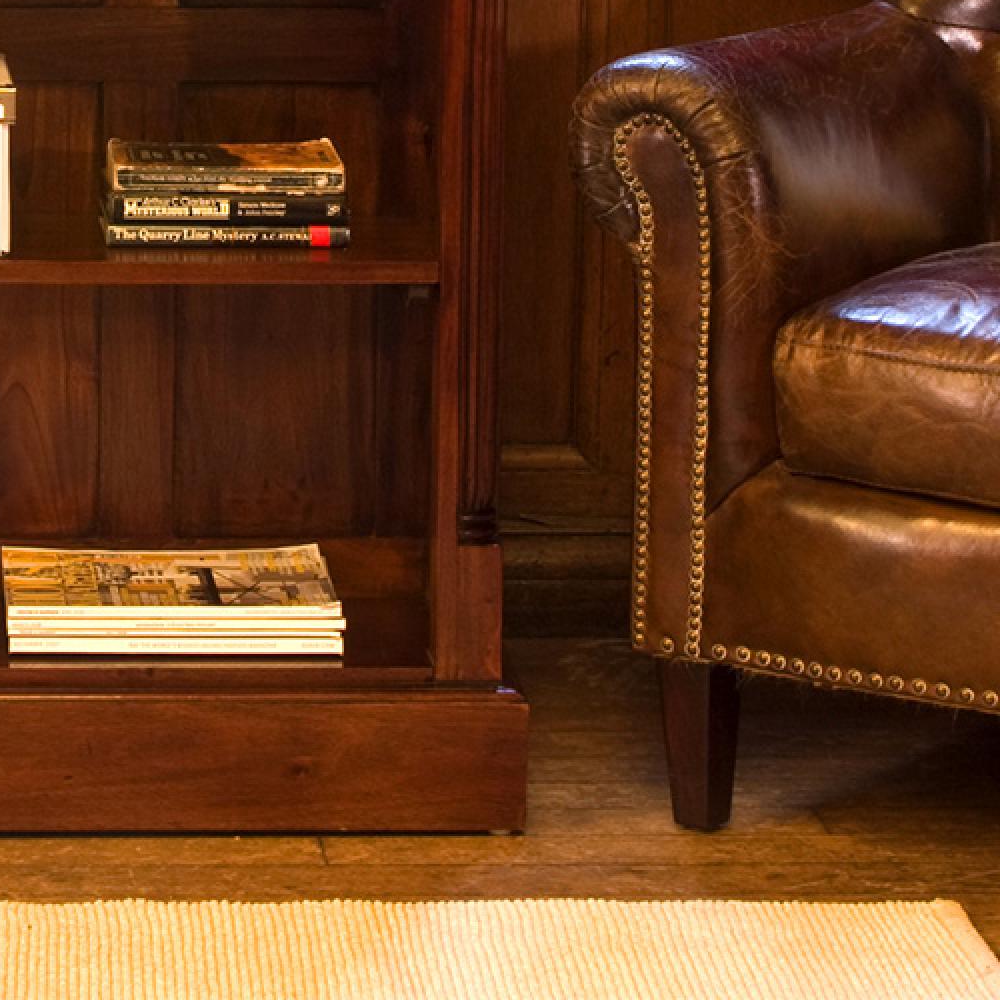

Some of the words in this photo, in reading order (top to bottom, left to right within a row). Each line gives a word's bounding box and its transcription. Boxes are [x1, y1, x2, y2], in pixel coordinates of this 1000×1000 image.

[112, 227, 137, 241] The
[139, 227, 182, 243] Quarry
[211, 227, 258, 243] Mystery
